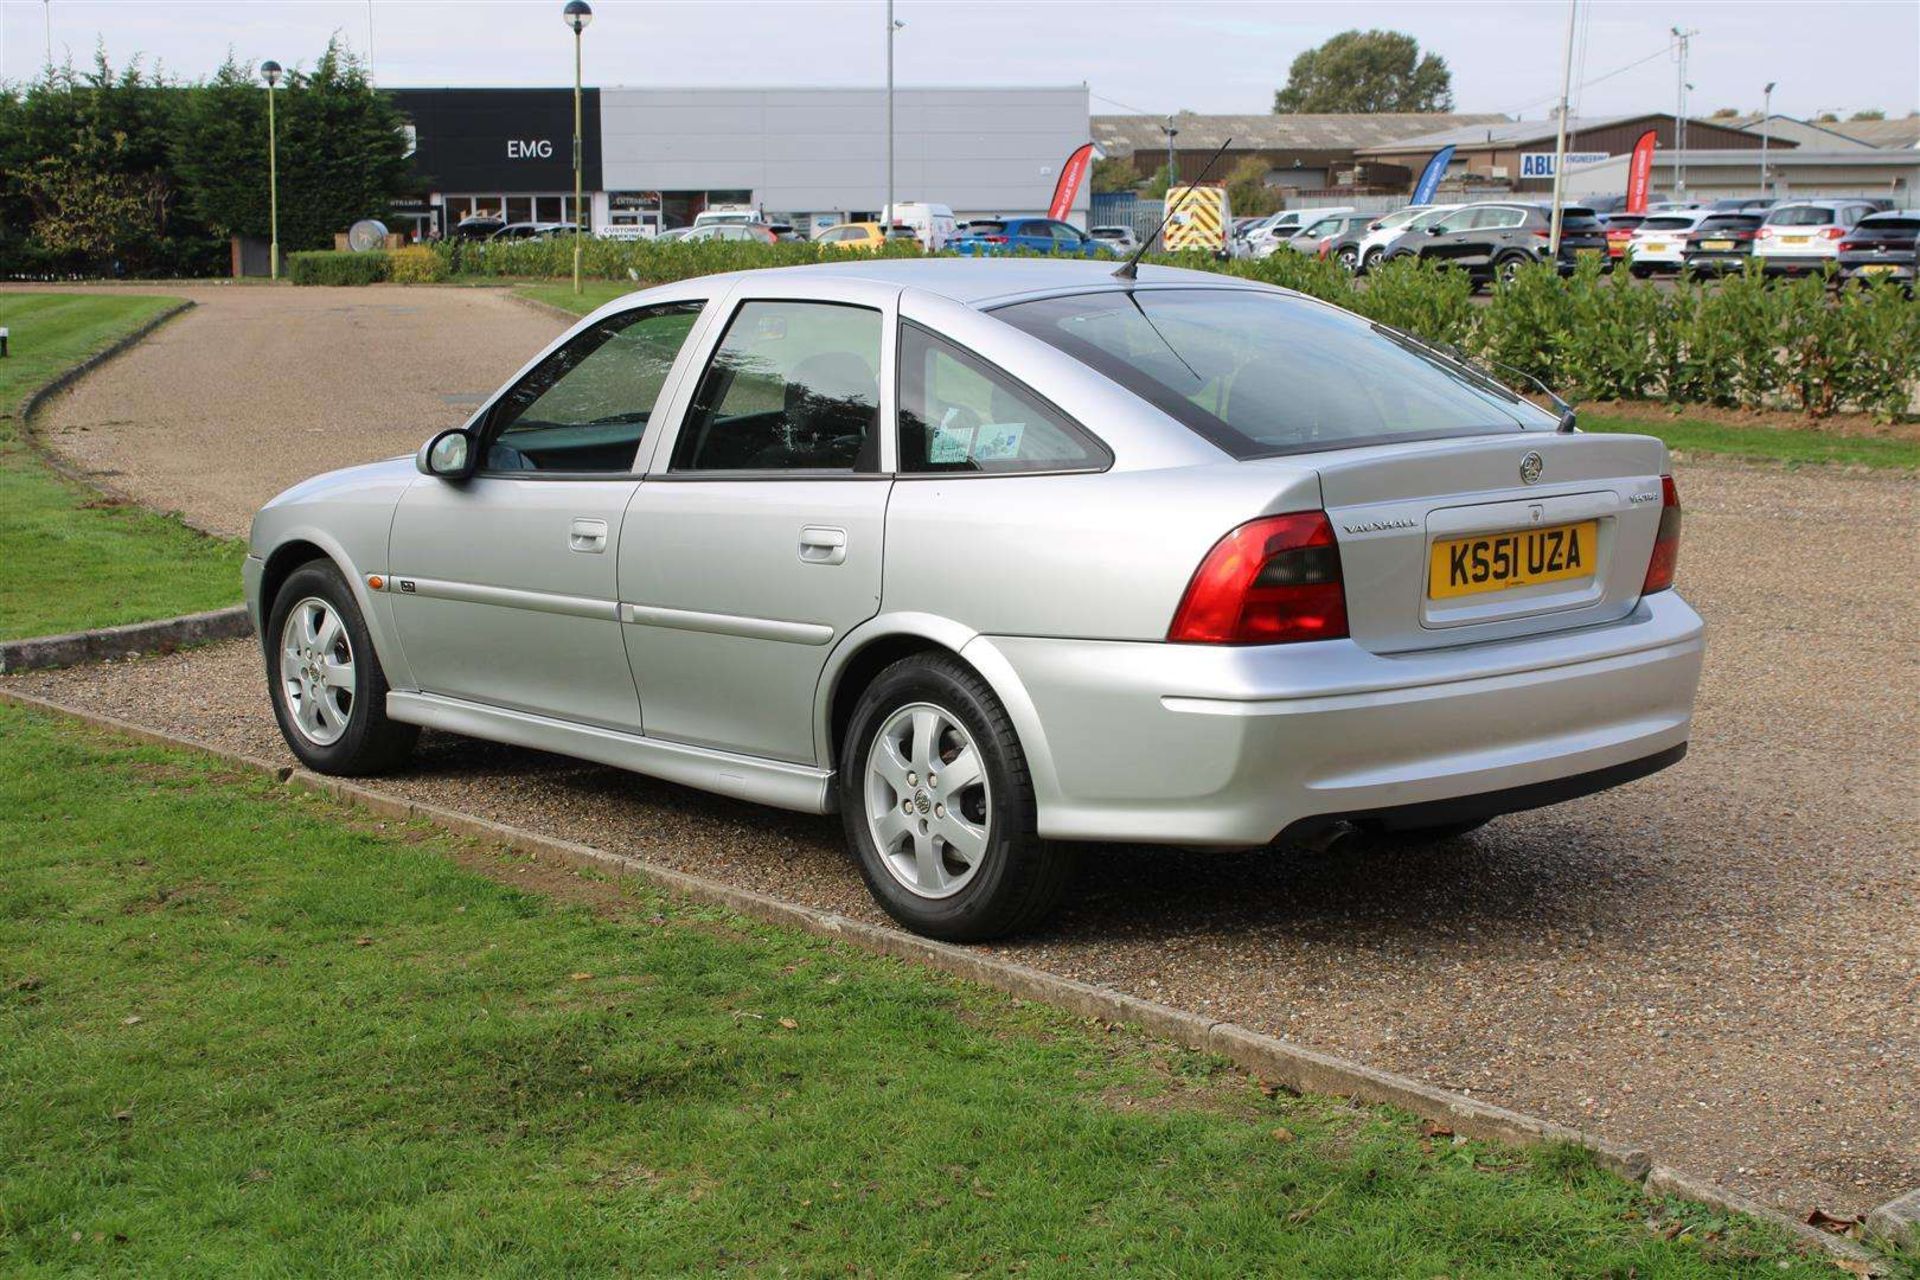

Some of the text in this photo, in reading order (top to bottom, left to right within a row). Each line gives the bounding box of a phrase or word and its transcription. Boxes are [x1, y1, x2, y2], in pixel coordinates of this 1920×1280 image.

[507, 140, 553, 158] EMG
[603, 226, 646, 234] CUSTOMER
[1343, 519, 1418, 533] VAUXHALL
[1450, 529, 1581, 587] KS51 UZA
